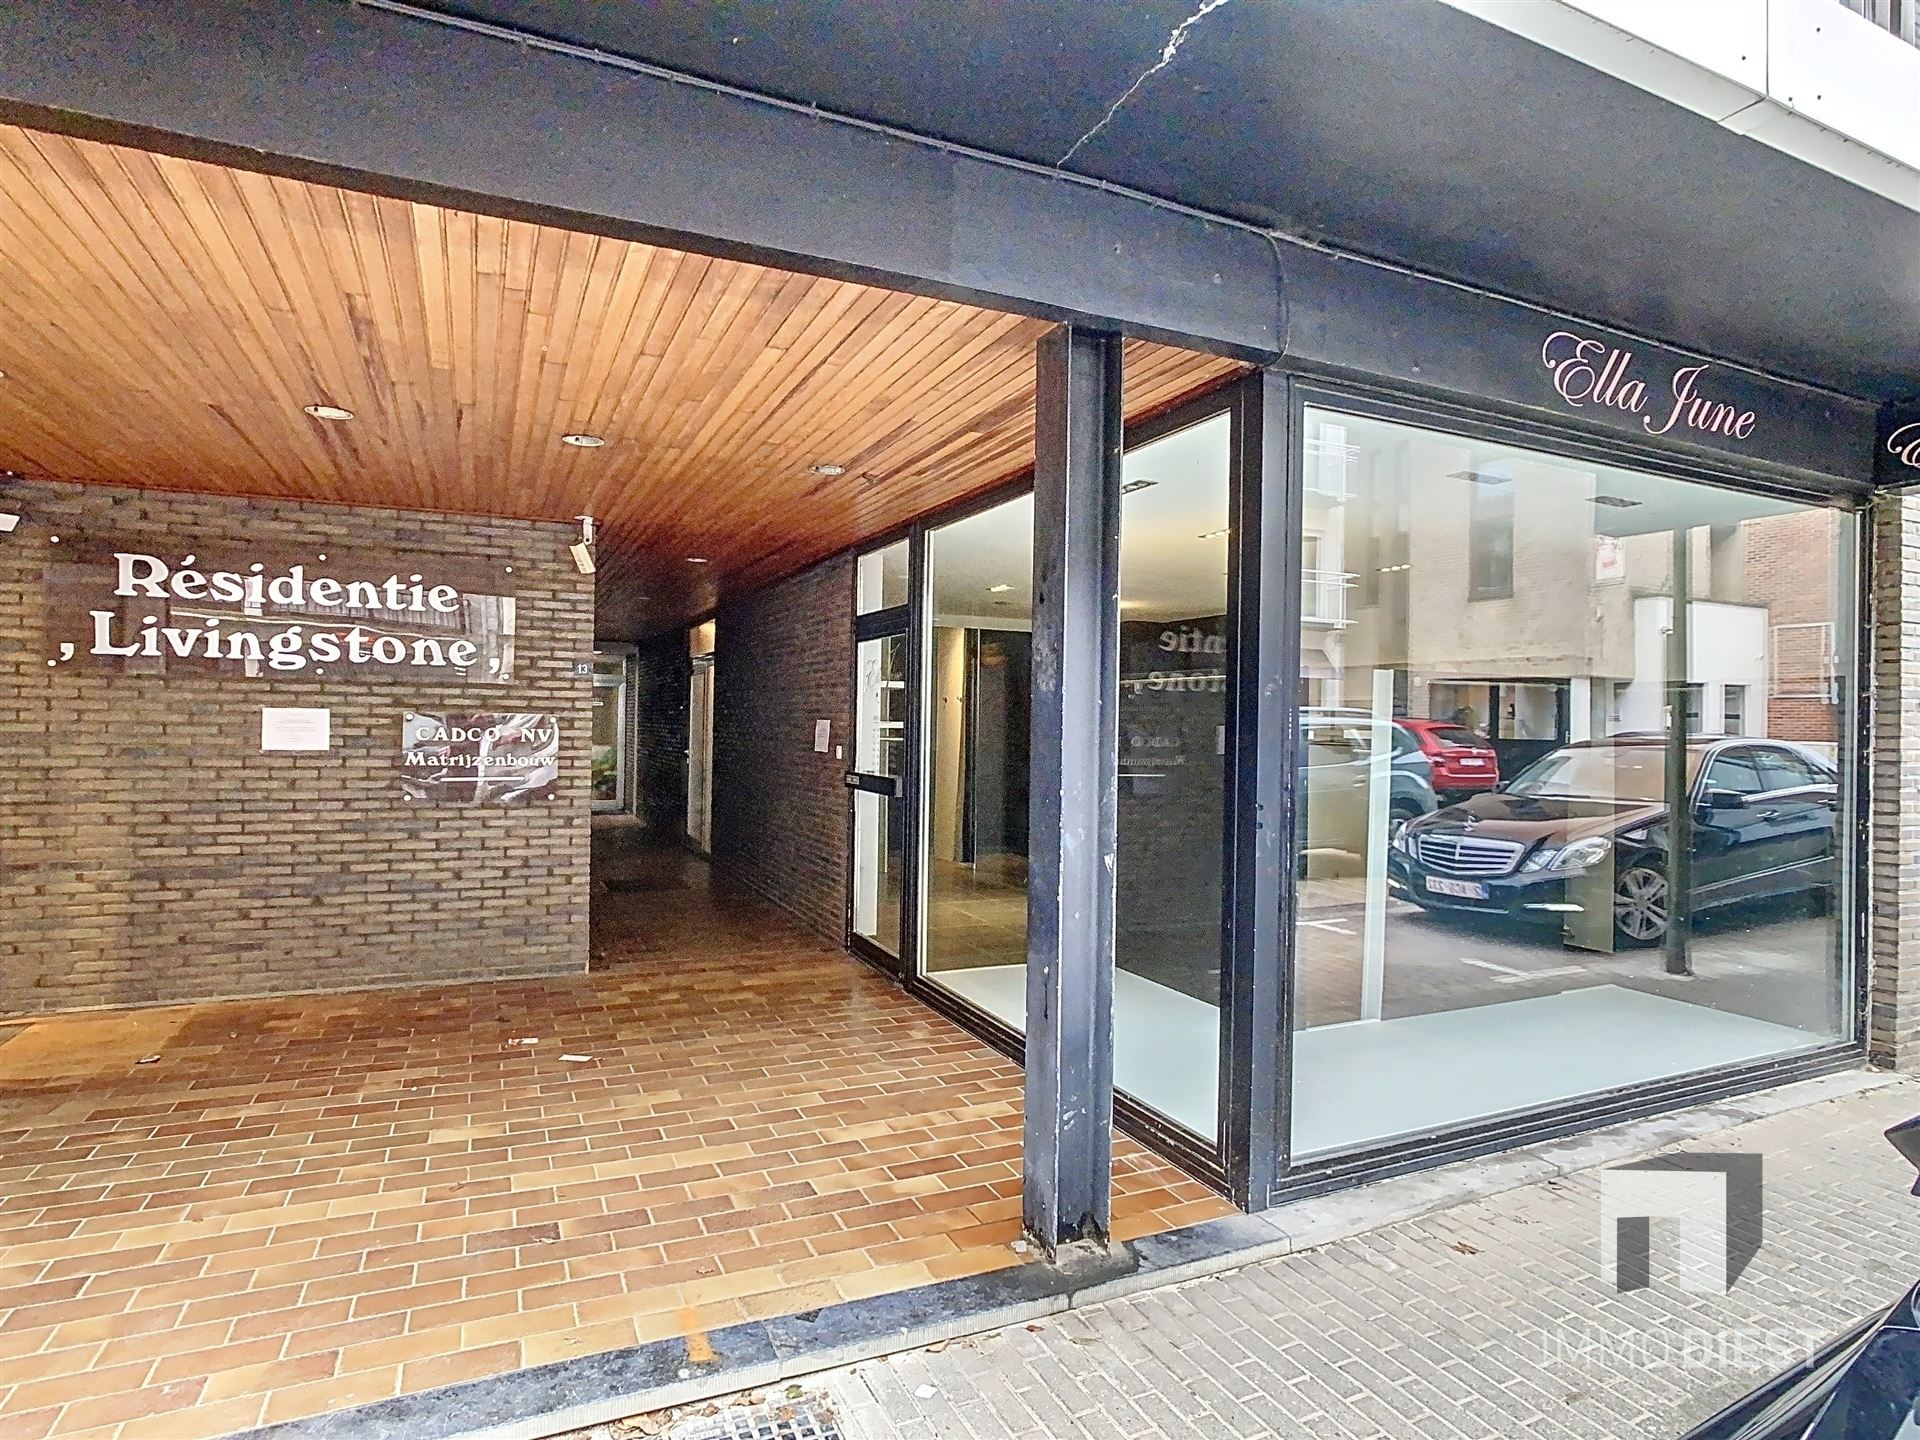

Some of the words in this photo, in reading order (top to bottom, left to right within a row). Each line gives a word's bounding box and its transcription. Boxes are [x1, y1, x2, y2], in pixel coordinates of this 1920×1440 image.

[1542, 331, 1649, 413] Ella
[1643, 364, 1756, 439] June
[113, 552, 461, 613] Résidentie
[577, 663, 588, 675] 13
[415, 726, 502, 743] CADCO
[520, 728, 554, 743] NV
[404, 751, 557, 769] Matrijzenbouw
